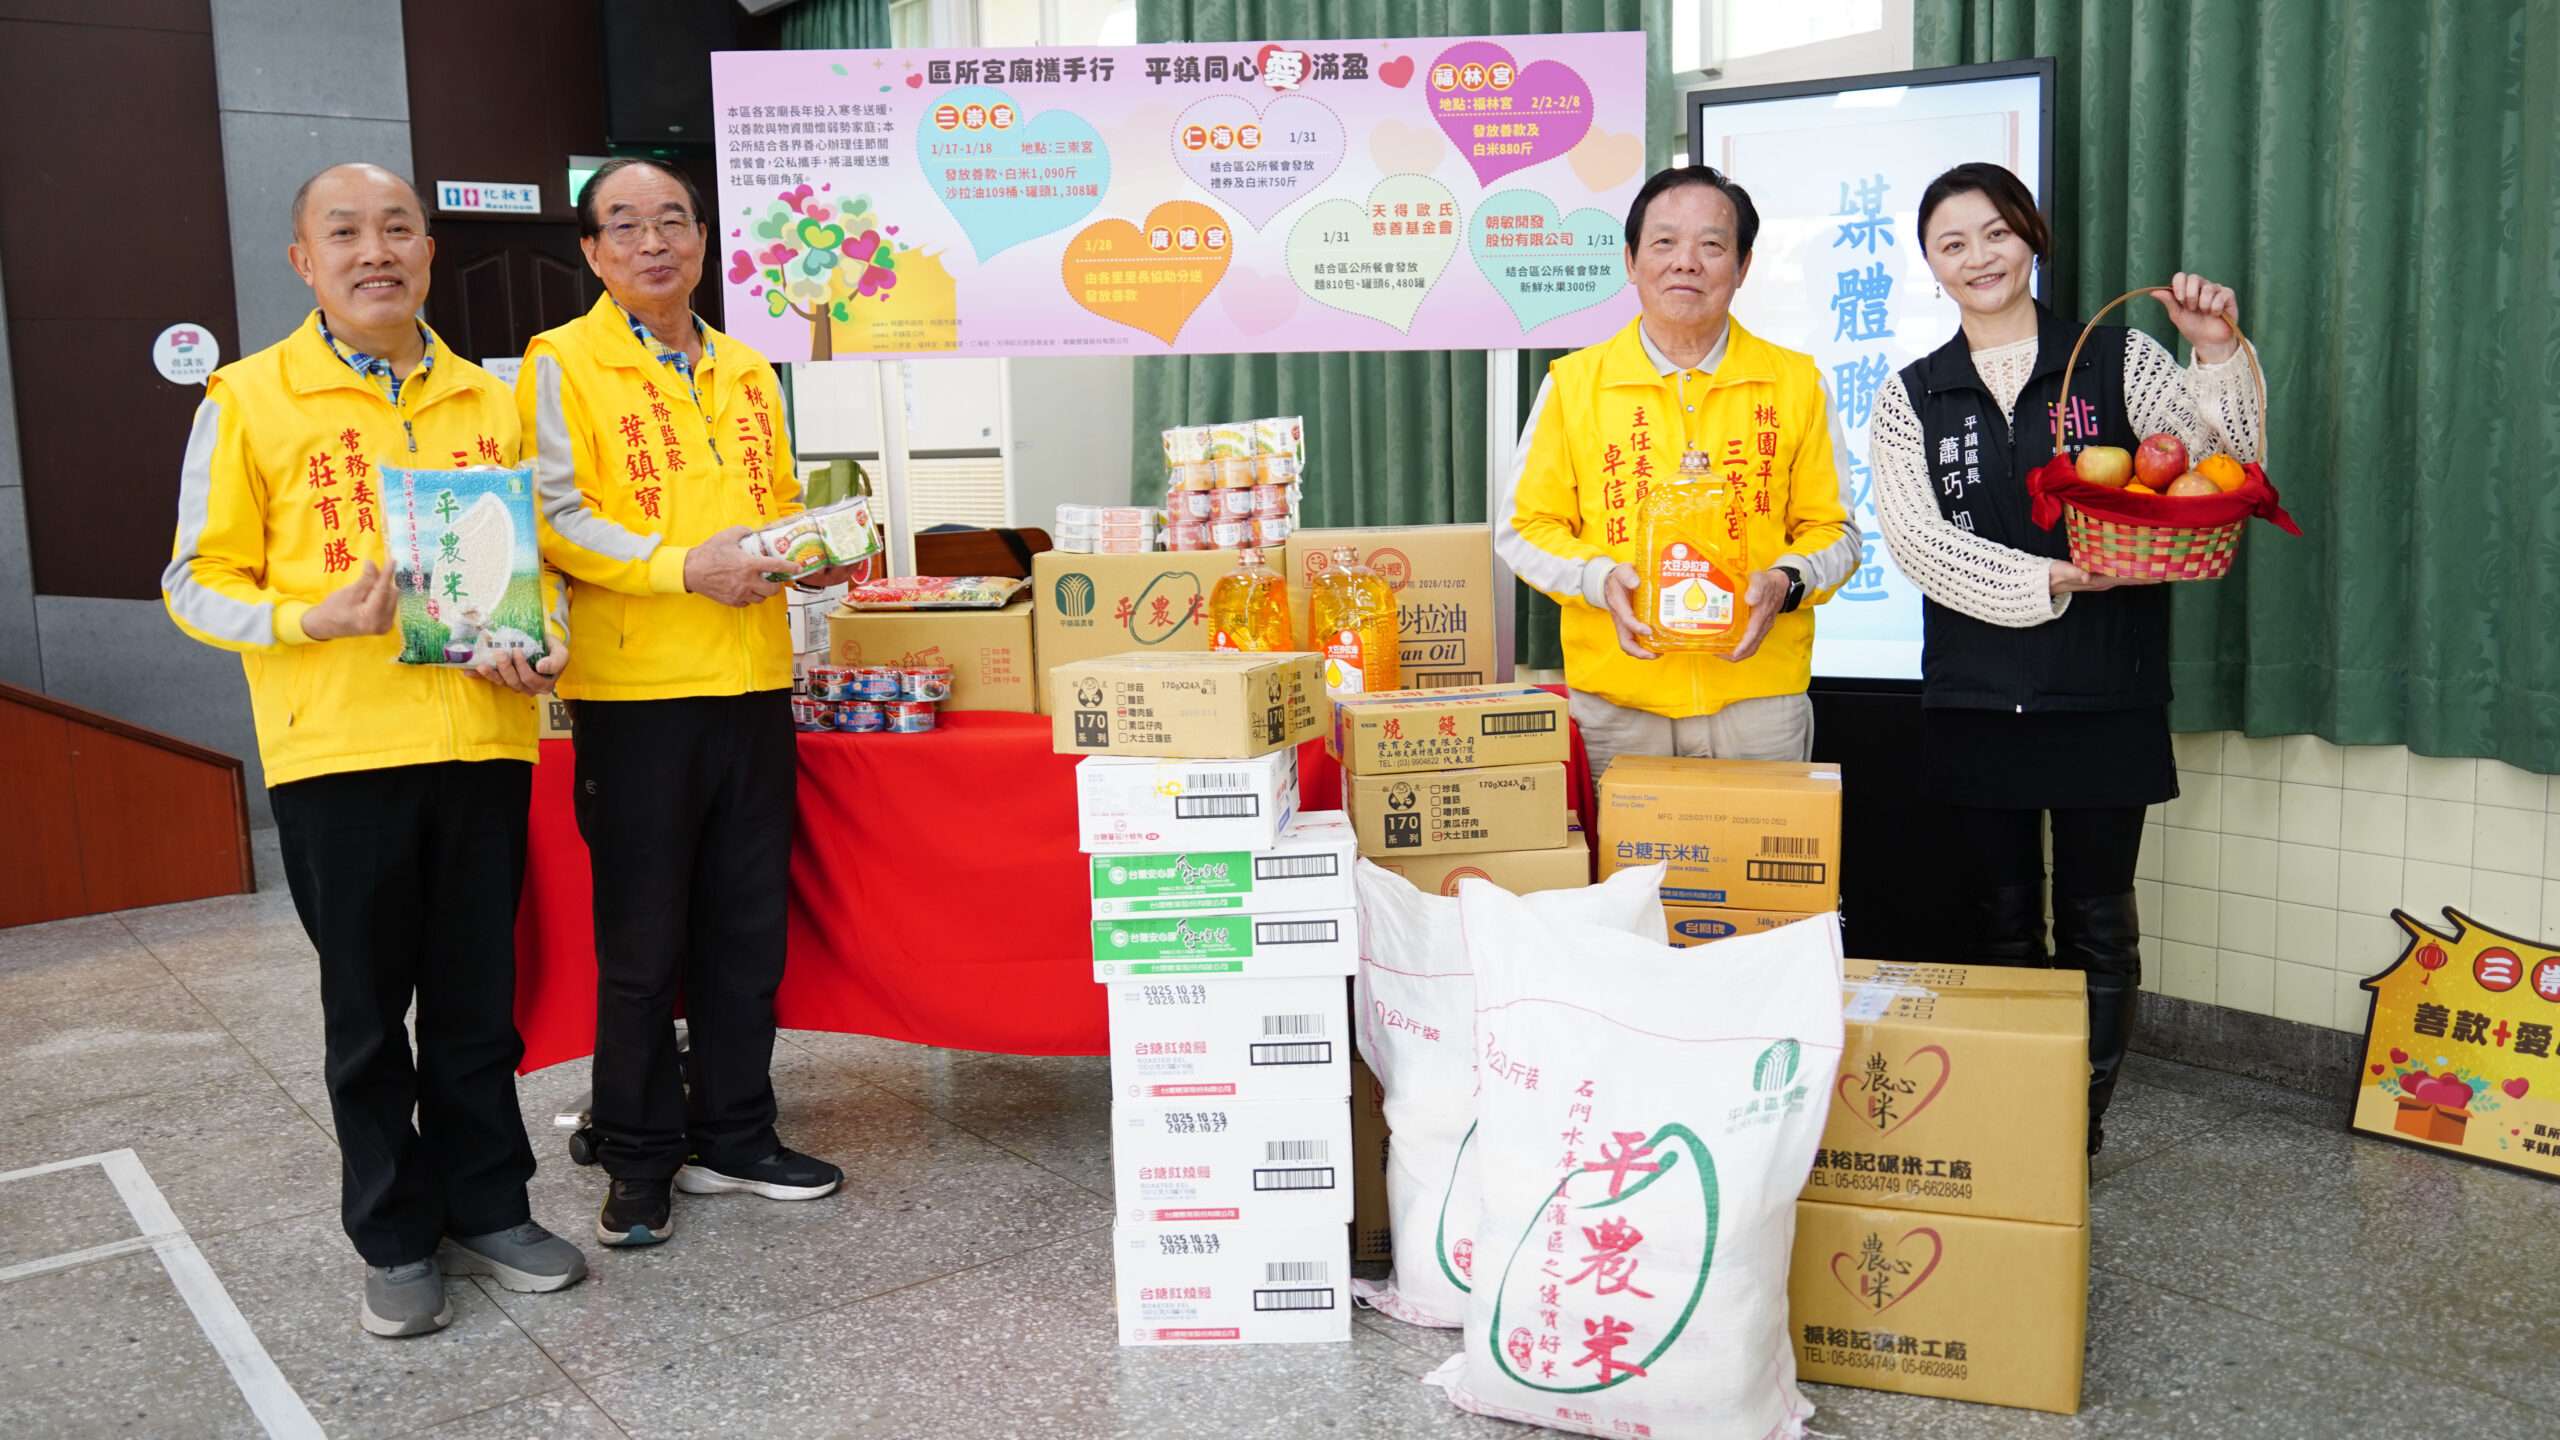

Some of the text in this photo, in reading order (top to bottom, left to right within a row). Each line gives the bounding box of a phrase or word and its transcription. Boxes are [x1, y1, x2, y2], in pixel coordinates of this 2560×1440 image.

[928, 49, 1369, 90] 區所宮廟攜手行 平鎮同心愛滿盈
[1435, 66, 1511, 86] 福林宮
[1531, 96, 1580, 110] 2/2-2/8
[936, 107, 1013, 128] 三崇宮
[1184, 125, 1317, 148] 仁海宮 1/31
[1473, 124, 1539, 138] 發放善款及
[931, 143, 993, 156] 1/17-1/18
[1473, 142, 1533, 156] 白米880斤
[1210, 160, 1315, 173] 結合區公所餐會發放
[1373, 220, 1453, 235] 慈善基金會
[1486, 215, 1545, 229] 朝敏開發
[1150, 227, 1226, 249] 廣隆宮
[1323, 231, 1350, 244] 1/31
[1486, 232, 1614, 247] 股份有限公司 1/31
[1314, 262, 1419, 274] 結合區公所餐會發放
[1505, 265, 1611, 278] 結合區公所餐會發放
[1520, 281, 1596, 293] 新鮮水果300份
[642, 380, 688, 473] 常務監察
[1630, 406, 1654, 505] 主任委員
[1963, 415, 1982, 485] 平鎮區長
[618, 413, 663, 522] 葉鎮寶
[735, 416, 768, 516] 三崇宮
[1754, 404, 1781, 521] 桃園平鎮
[339, 428, 377, 534] 常務委員
[1722, 439, 1750, 541] 三崇宮
[1938, 436, 1976, 533] 蕭巧如
[1601, 443, 1631, 546] 卓信旺
[308, 451, 359, 574] 莊育勝
[434, 490, 469, 604] 平農米
[1114, 594, 1209, 629] 平農米
[1429, 644, 1458, 661] Oil
[1077, 714, 1106, 729] 170
[1388, 816, 1419, 830] 170
[1615, 840, 1711, 864] 台糖玉米粒
[2414, 1002, 2560, 1059] 善款+愛
[1905, 1179, 1973, 1199] 05-6628849
[1565, 1131, 1661, 1385] 平農米
[1803, 1323, 1967, 1361] 振裕記碾米工廠
[1901, 1359, 1968, 1380] 05-6628849
